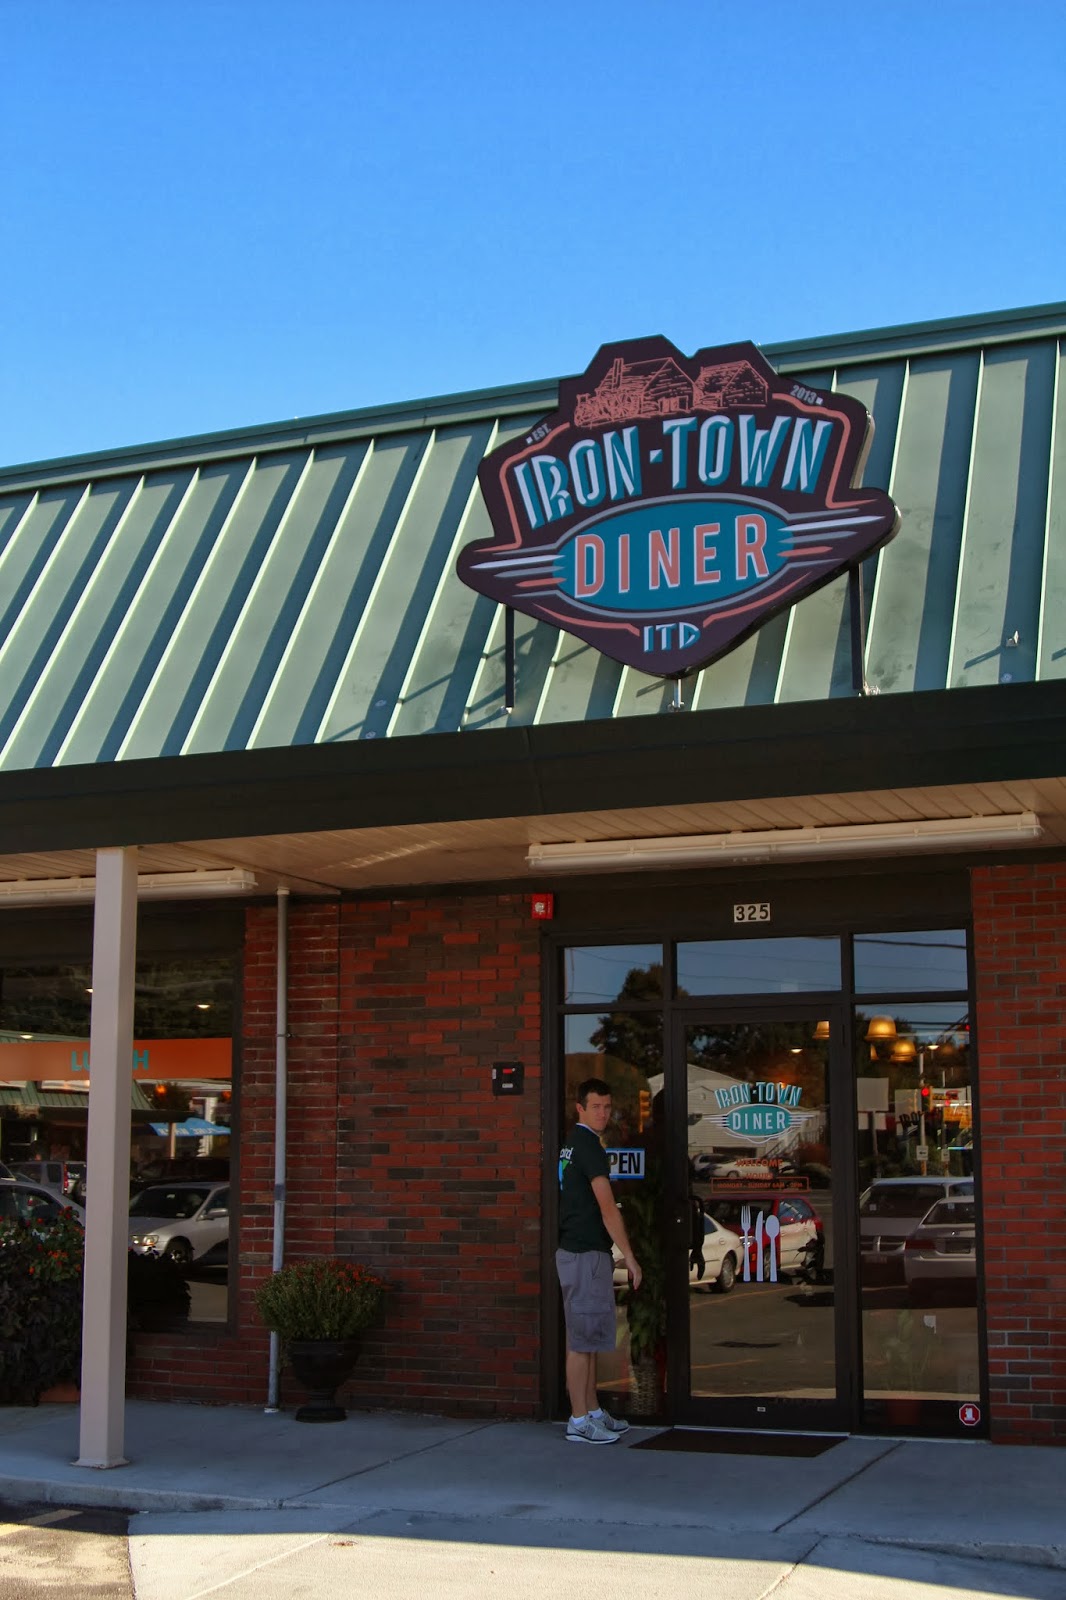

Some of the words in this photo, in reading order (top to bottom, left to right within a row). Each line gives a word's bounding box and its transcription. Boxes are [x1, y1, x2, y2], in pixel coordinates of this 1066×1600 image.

[790, 384, 817, 405] 2013
[531, 423, 552, 442] EST.
[573, 513, 770, 599] DINER
[736, 904, 769, 921] 325
[732, 1111, 786, 1131] DINER
[605, 1152, 641, 1175] PEN
[735, 1159, 783, 1167] WELCOME
